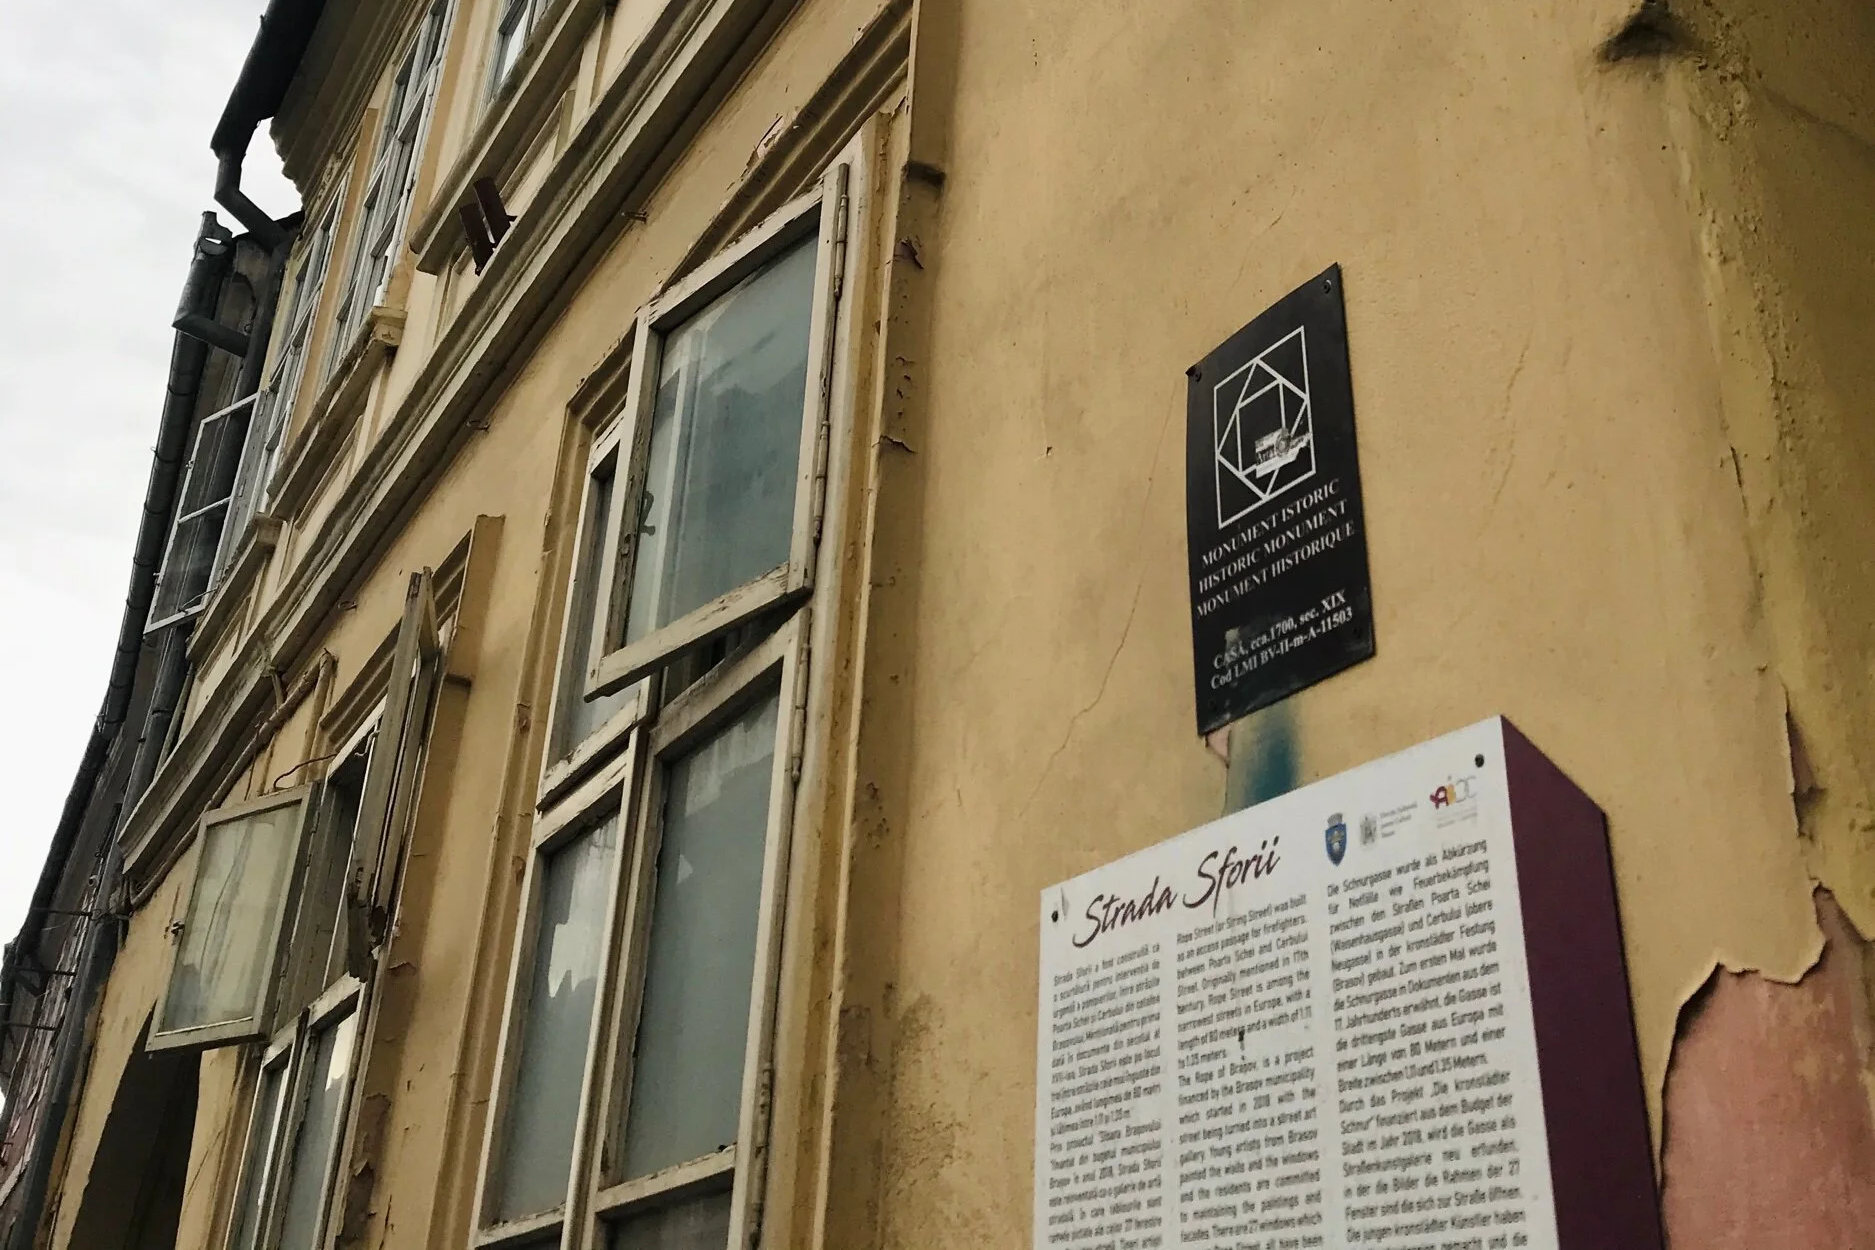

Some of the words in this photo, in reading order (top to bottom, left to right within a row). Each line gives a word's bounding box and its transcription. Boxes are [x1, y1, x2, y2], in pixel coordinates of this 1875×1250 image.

[1197, 567, 1269, 620] MONUMENT
[1271, 518, 1355, 578] HISTORIQUE
[1199, 548, 1260, 594] HISTORIC
[1263, 499, 1347, 559] MONUMENT
[1202, 512, 1279, 568] MONUMENT
[1281, 478, 1340, 523] ISTORIC
[1300, 608, 1320, 624] sec.
[1321, 589, 1347, 614] XIX
[1210, 669, 1232, 690] Cod
[1072, 876, 1177, 948] Strada
[1183, 836, 1280, 918] Sforii
